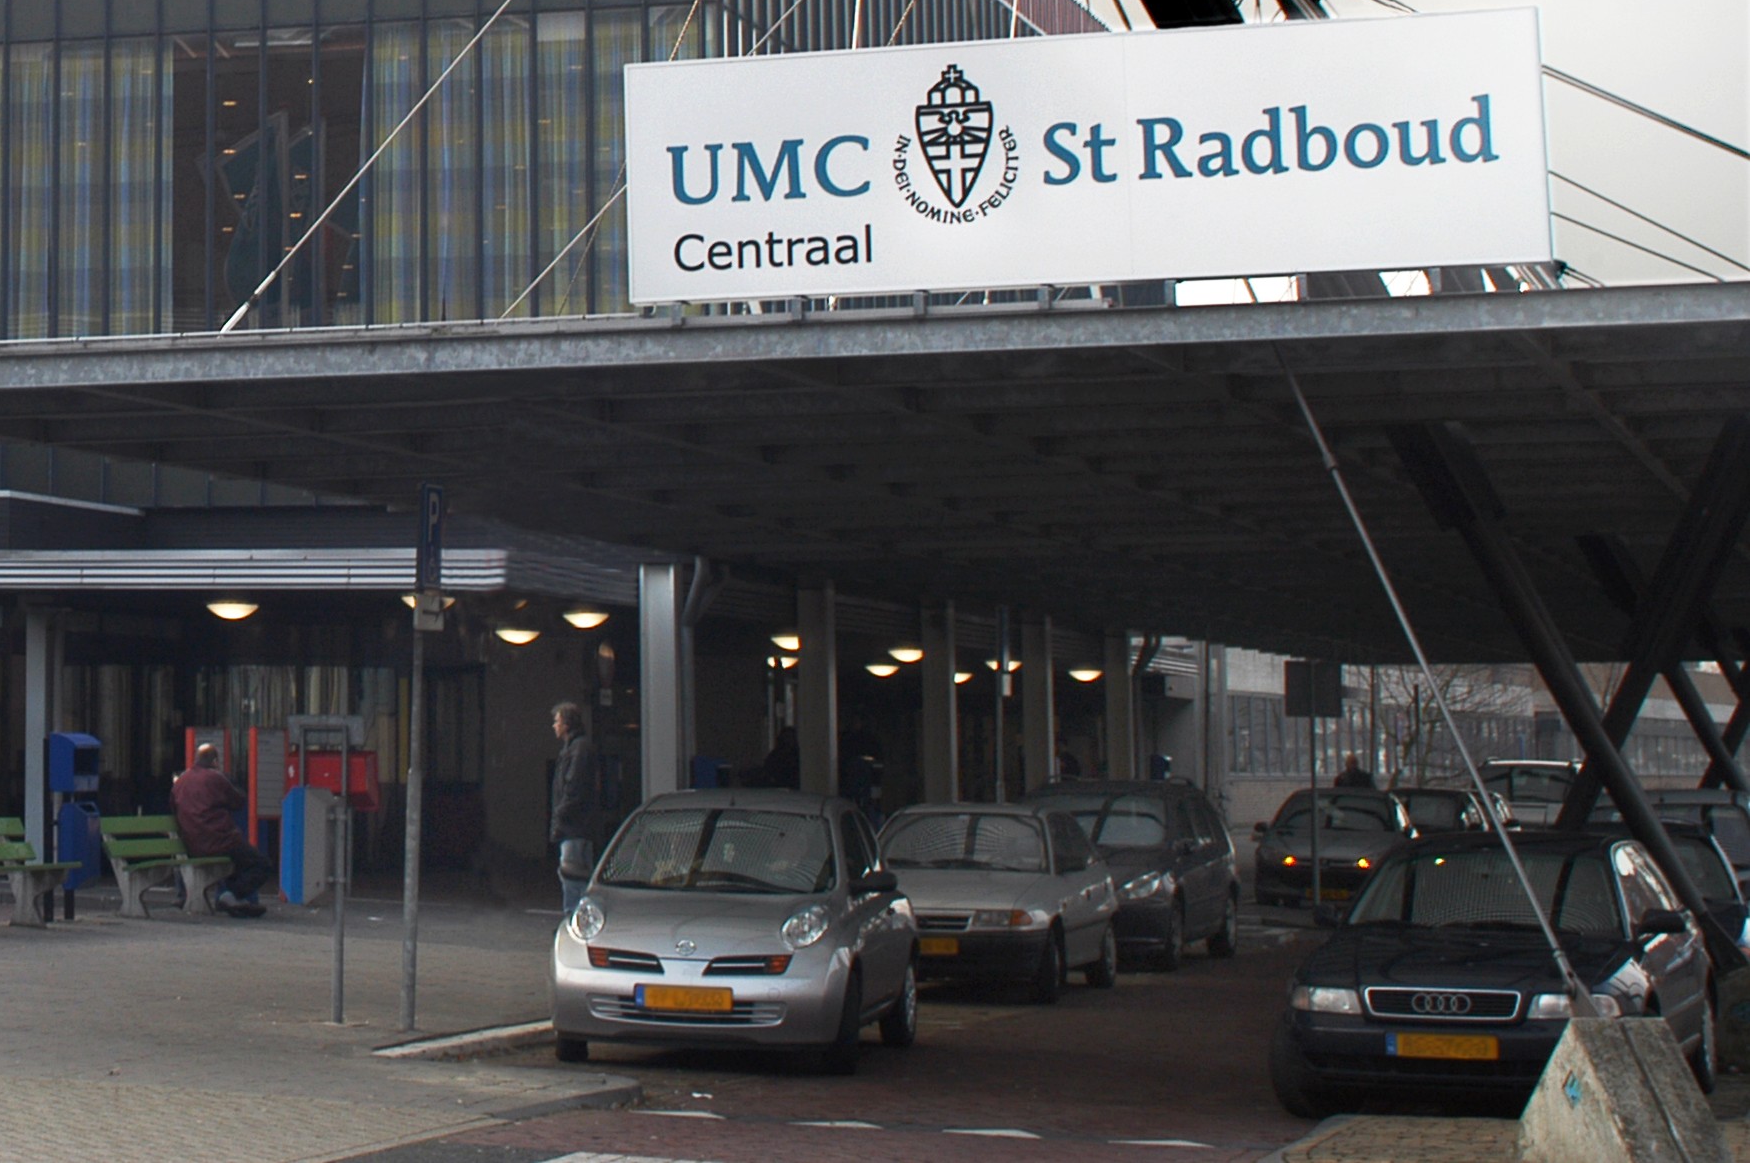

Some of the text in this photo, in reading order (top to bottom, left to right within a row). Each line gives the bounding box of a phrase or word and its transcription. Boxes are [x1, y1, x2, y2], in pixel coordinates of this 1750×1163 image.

[666, 93, 1500, 205] UMC St Radboud
[674, 224, 873, 272] Centraal
[428, 491, 441, 544] P
